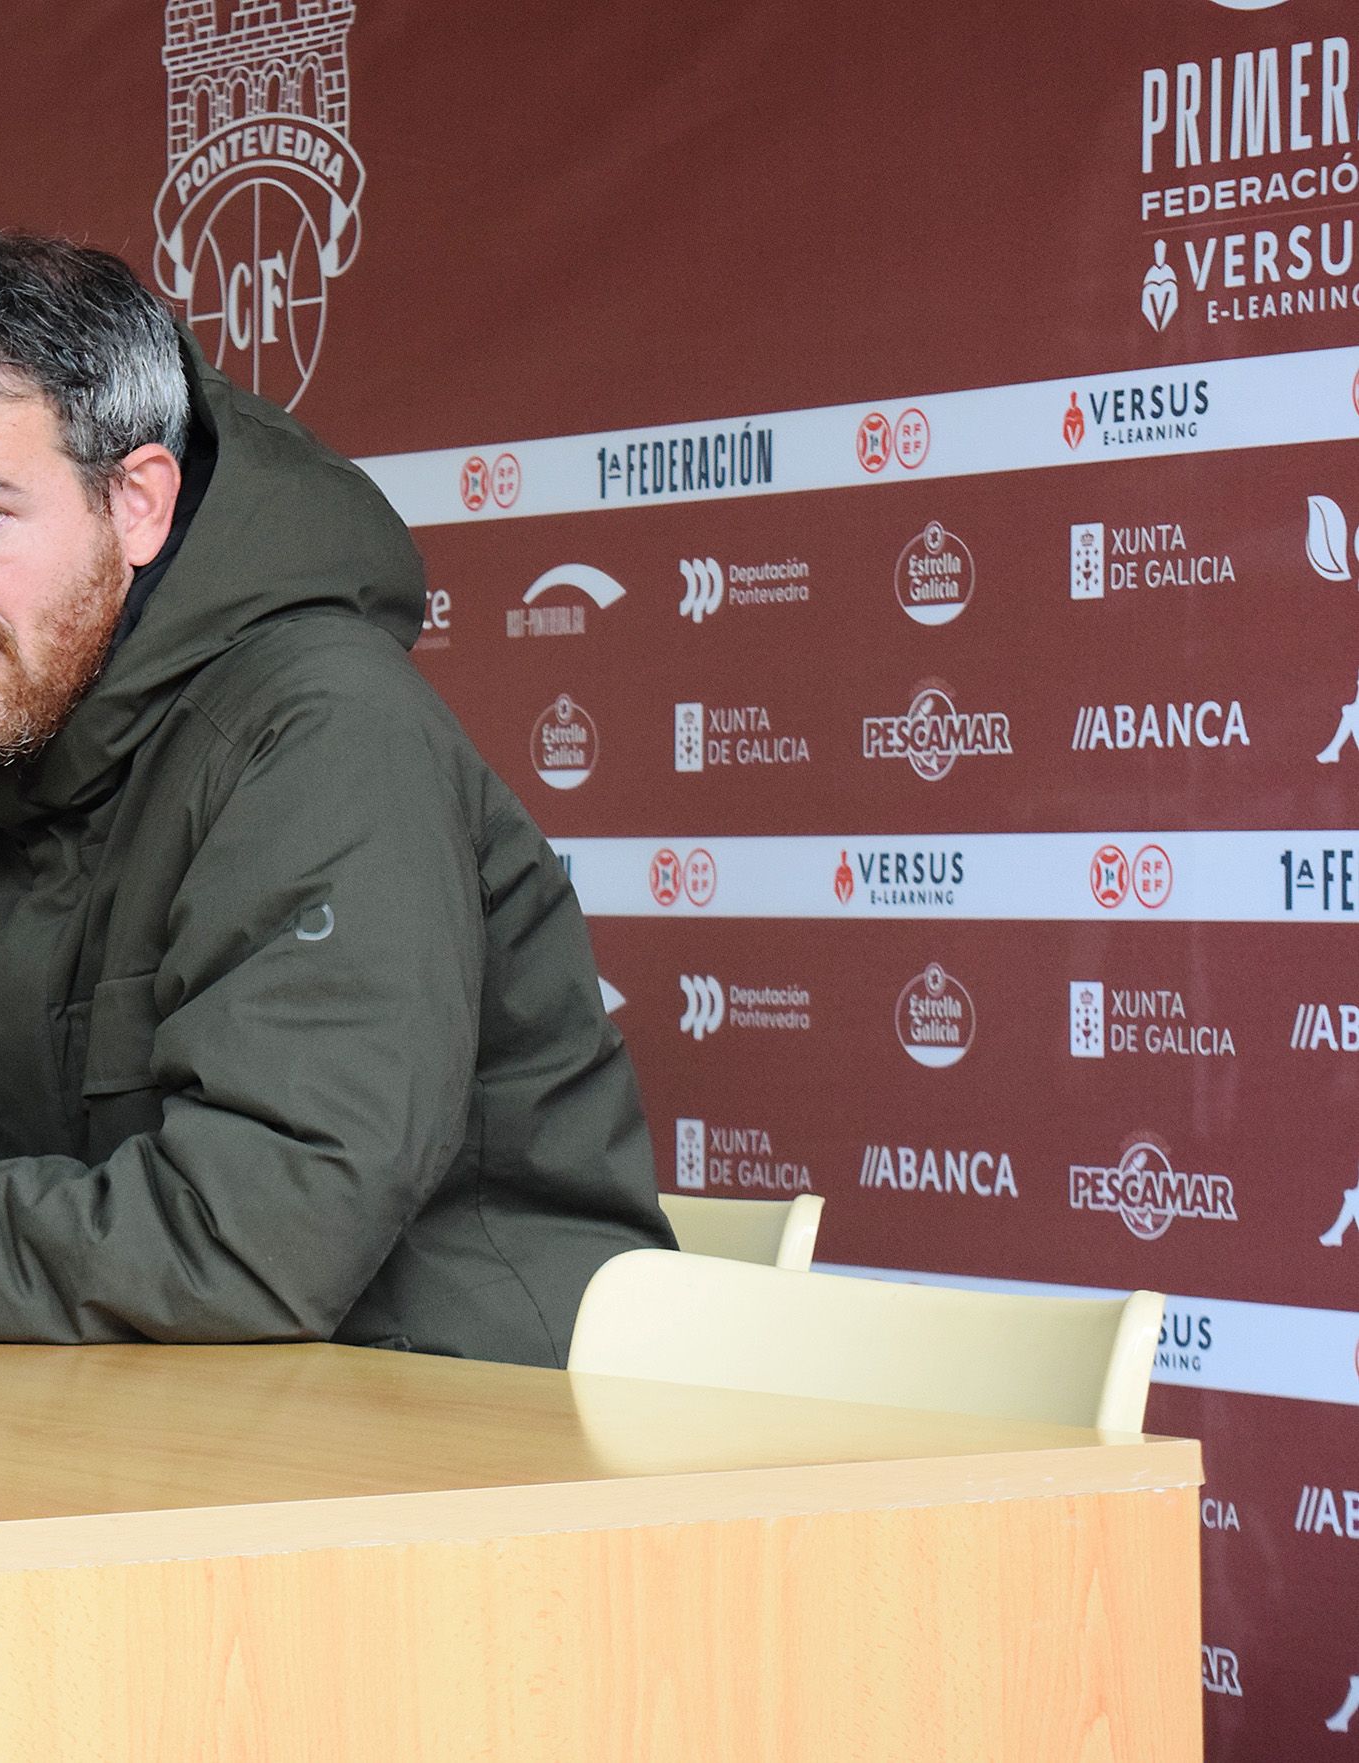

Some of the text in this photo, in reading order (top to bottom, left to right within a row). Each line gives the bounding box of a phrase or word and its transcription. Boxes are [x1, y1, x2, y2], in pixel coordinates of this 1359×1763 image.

[1142, 36, 1359, 173] PRIMER
[175, 124, 345, 205] PONTEVEDRA
[1142, 152, 1359, 221] FEDERACIÓ
[1184, 219, 1353, 292] VERSU
[229, 250, 287, 350] CF
[1090, 380, 1209, 425] VERSUS
[1103, 422, 1198, 446] E-LEARNING
[626, 422, 772, 497] FEDERACIÓN
[1111, 524, 1186, 556] XUNTA
[729, 557, 809, 584] Deputación
[908, 553, 962, 578] Estrella
[1111, 556, 1236, 591] DE GALICIA
[729, 583, 809, 605] Pontevedra
[910, 577, 960, 602] Galicia
[708, 706, 770, 733] XUNTA
[543, 723, 587, 745] Estrella
[863, 712, 1013, 759] PESCAMAR
[543, 744, 585, 767] Galicia
[708, 737, 810, 765] DE GALICIA
[858, 851, 964, 885] VERSUS
[871, 889, 954, 905] E-LEARNING
[730, 985, 810, 1008] Deputación
[909, 994, 962, 1020] Estrella
[1111, 990, 1186, 1019] XUNTA
[730, 1010, 810, 1030] Pontevedra
[910, 1019, 959, 1043] Galicia
[1111, 1024, 1236, 1056] DE GALICIA
[710, 1128, 771, 1156] XUNTA
[710, 1158, 812, 1191] DE GALICIA
[1070, 1165, 1238, 1221] PESCAMAR
